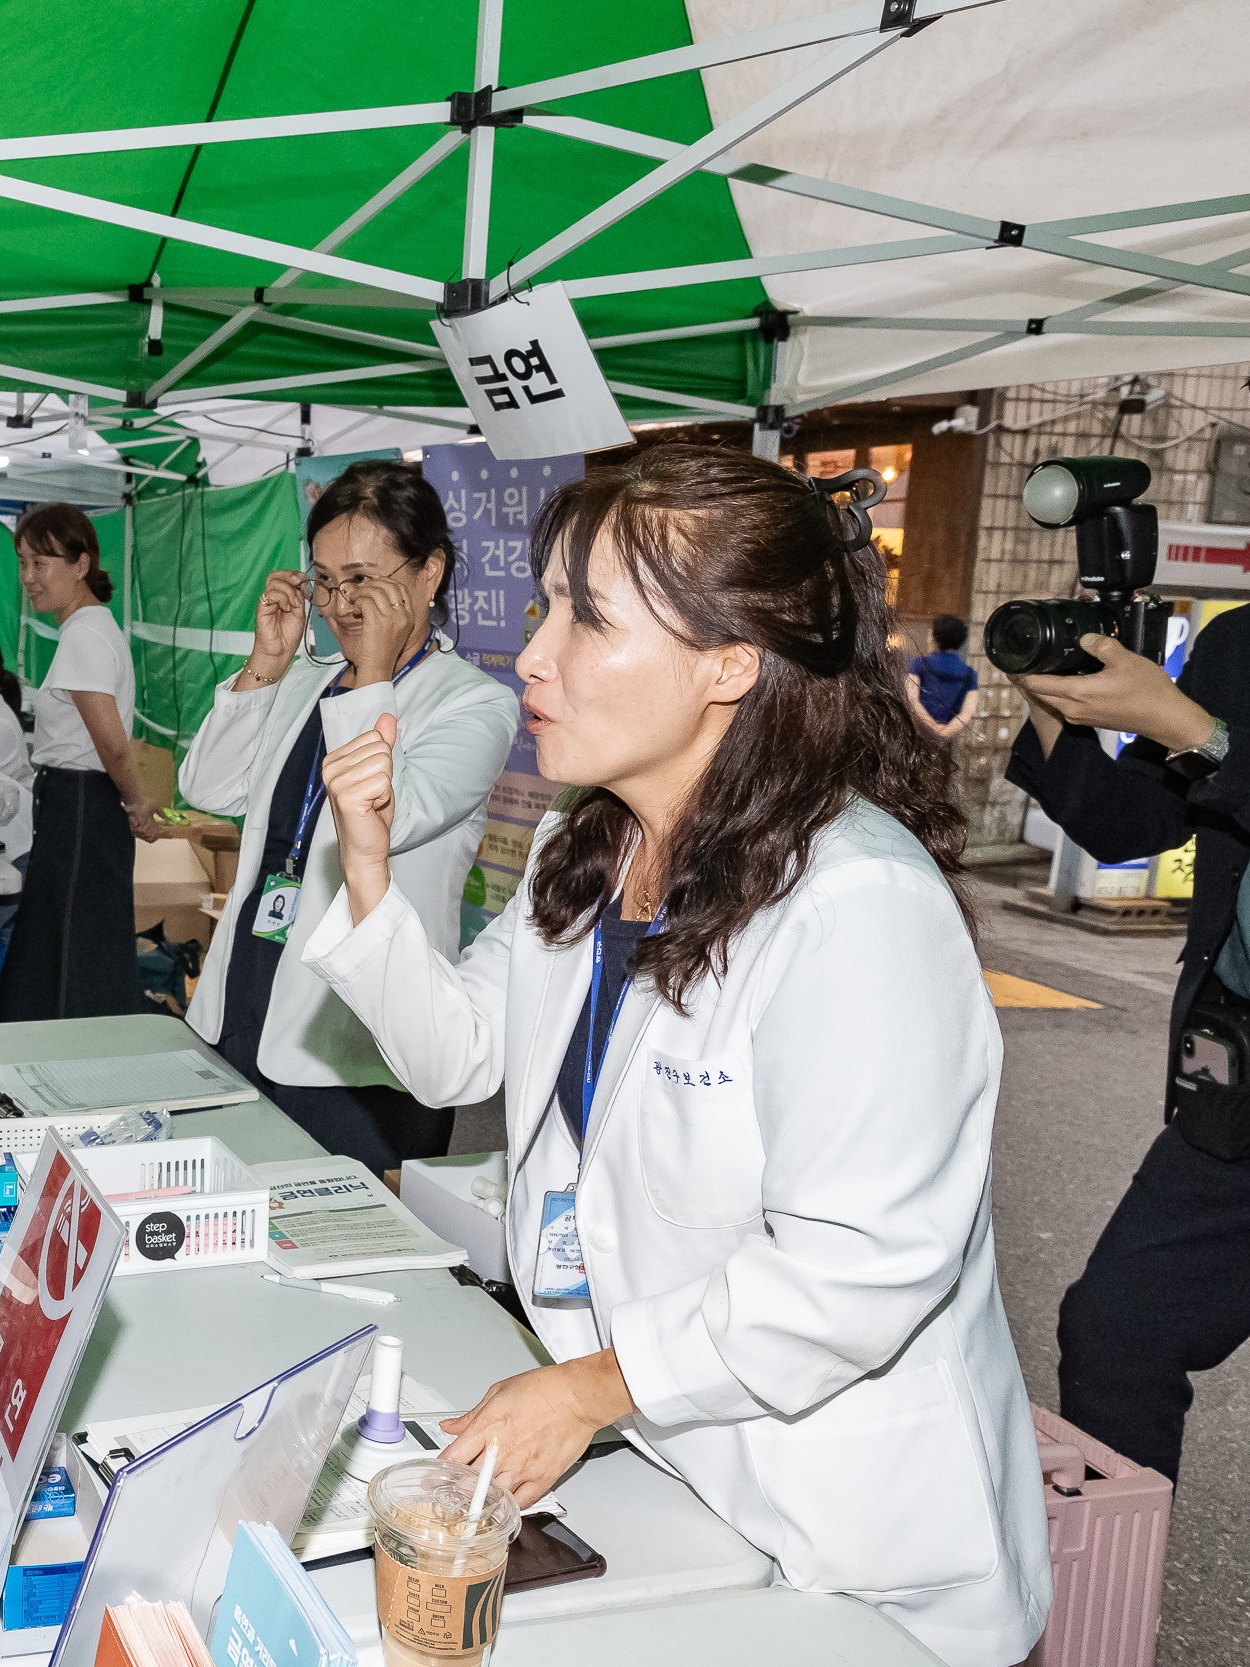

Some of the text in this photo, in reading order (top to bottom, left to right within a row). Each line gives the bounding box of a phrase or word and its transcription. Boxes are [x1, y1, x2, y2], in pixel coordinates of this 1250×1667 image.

[468, 339, 566, 412] 금연
[445, 486, 546, 528] 싱거워
[653, 1060, 734, 1087] 광진구보건소
[278, 1181, 370, 1201] 금연클리닉
[145, 1222, 167, 1233] step
[145, 1232, 177, 1244] basket
[233, 1603, 256, 1645] 흡연과
